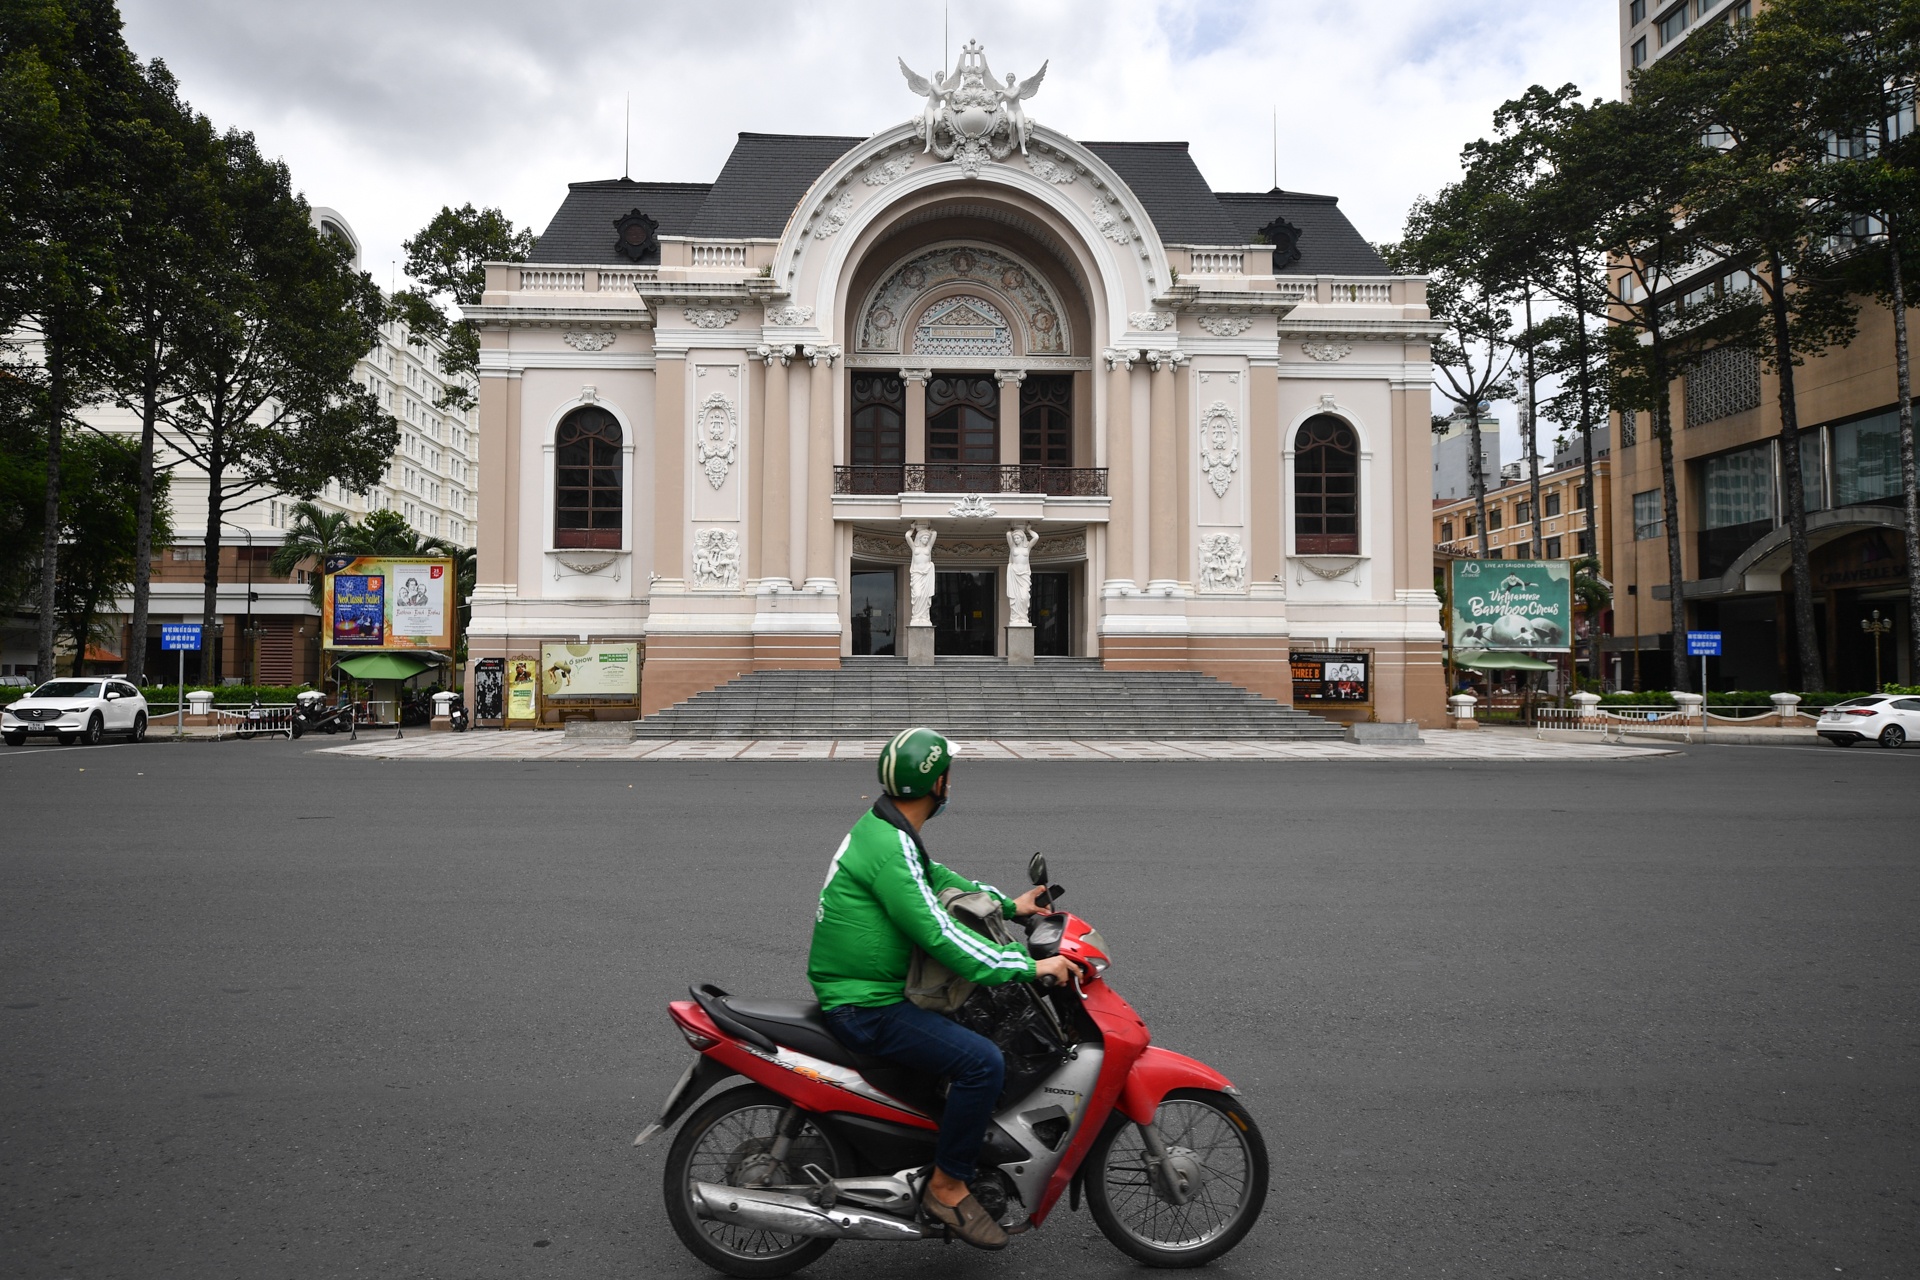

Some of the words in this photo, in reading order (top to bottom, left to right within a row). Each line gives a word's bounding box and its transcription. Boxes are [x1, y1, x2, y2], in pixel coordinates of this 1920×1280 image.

[1820, 566, 1889, 584] CARAVELLE
[1489, 588, 1540, 605] Vietnamese
[1468, 597, 1528, 616] Bamboo
[1528, 602, 1559, 615] Circus
[1292, 668, 1313, 678] THREE
[919, 746, 942, 773] Grab
